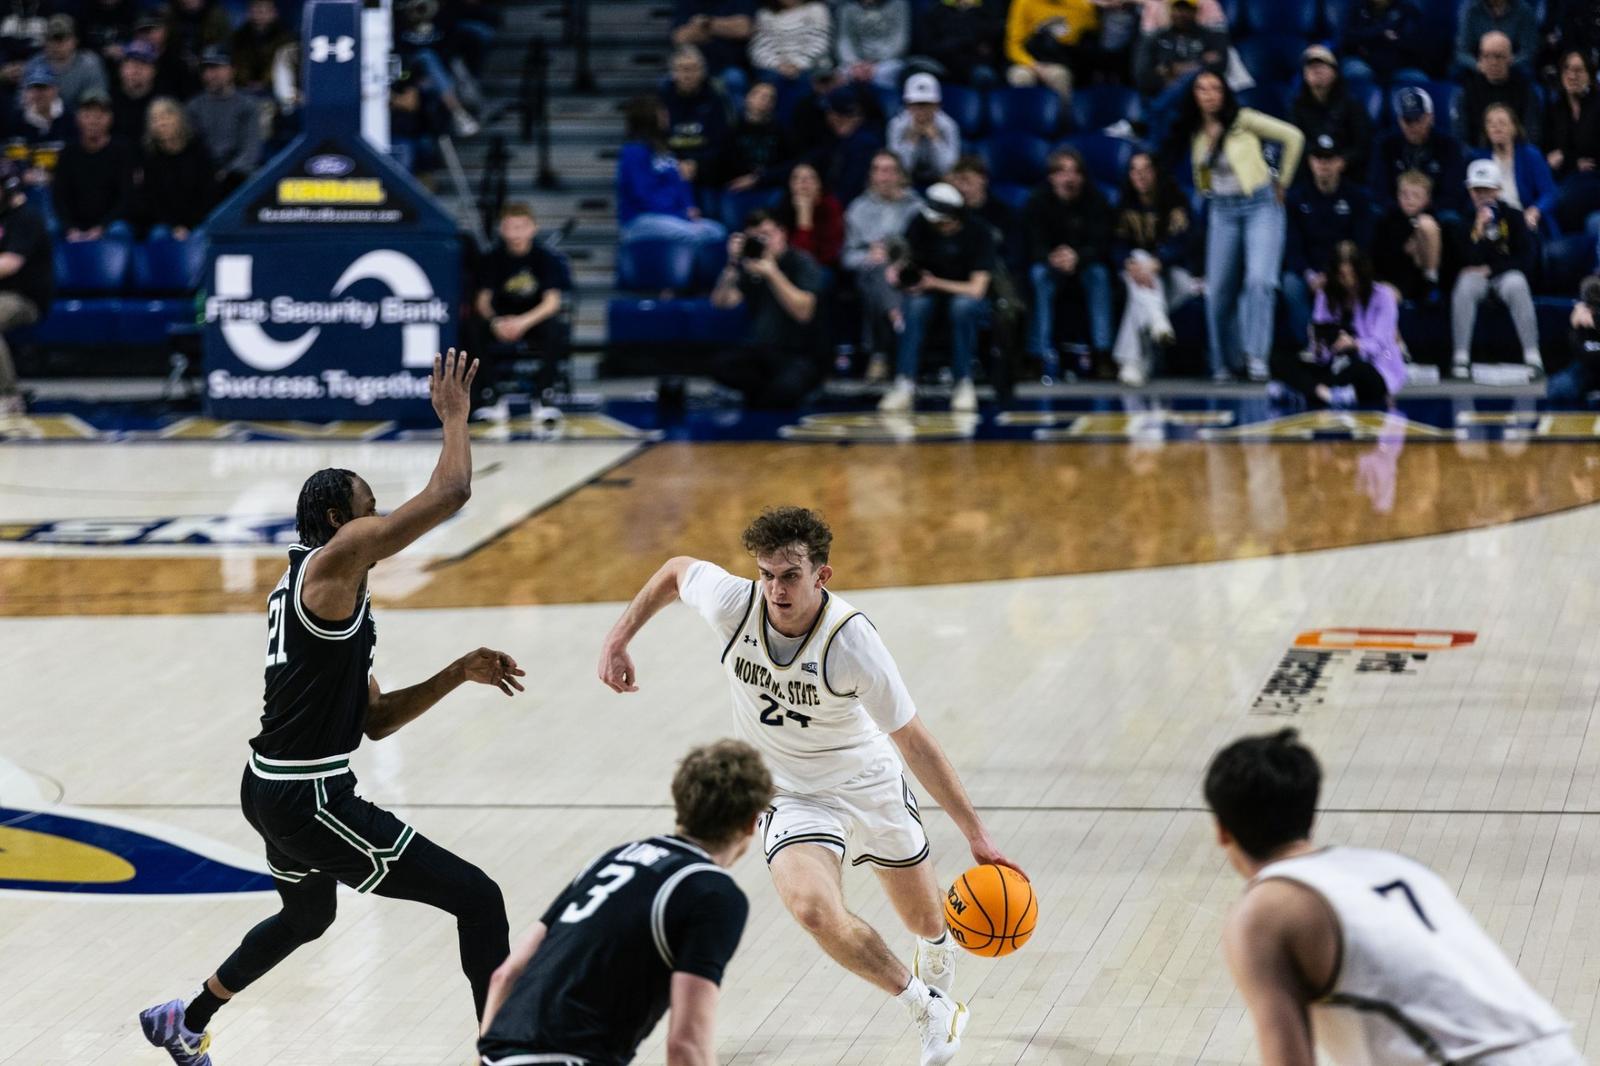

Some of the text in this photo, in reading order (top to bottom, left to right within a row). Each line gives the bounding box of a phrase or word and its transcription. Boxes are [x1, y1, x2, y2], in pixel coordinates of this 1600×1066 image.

[205, 296, 449, 329] First Security Bank
[321, 370, 432, 405] Togethe
[266, 592, 288, 667] 21
[788, 680, 820, 707] STATE
[559, 862, 636, 923] 3
[1371, 879, 1437, 933] 7
